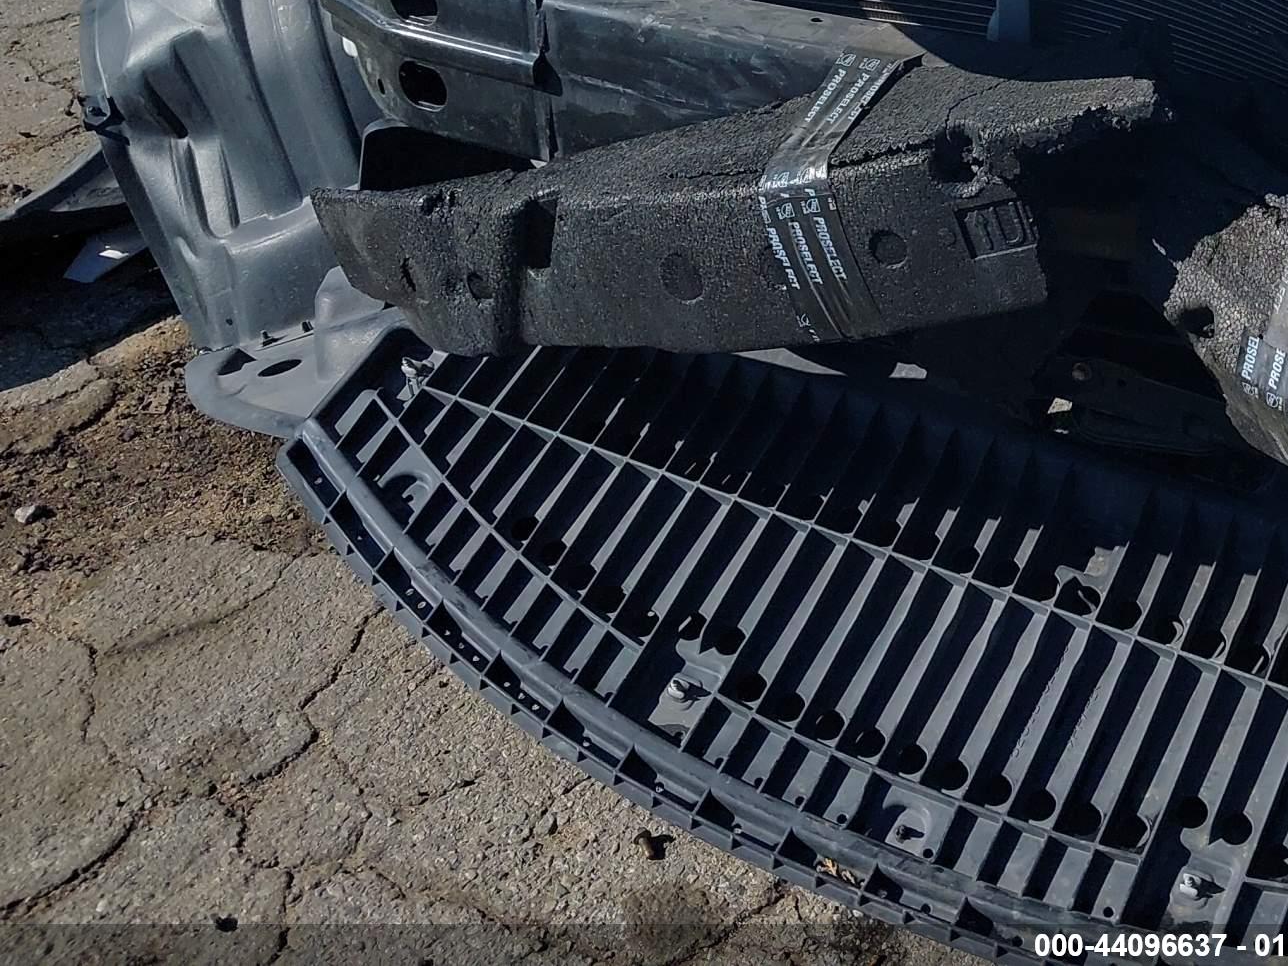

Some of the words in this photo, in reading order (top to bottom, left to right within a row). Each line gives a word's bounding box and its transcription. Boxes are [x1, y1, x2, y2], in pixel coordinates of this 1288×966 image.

[804, 68, 847, 123] PROSELECT
[826, 72, 871, 124] PROSELECT
[788, 221, 823, 285] PROSELECT
[813, 215, 847, 281] PROSELECT
